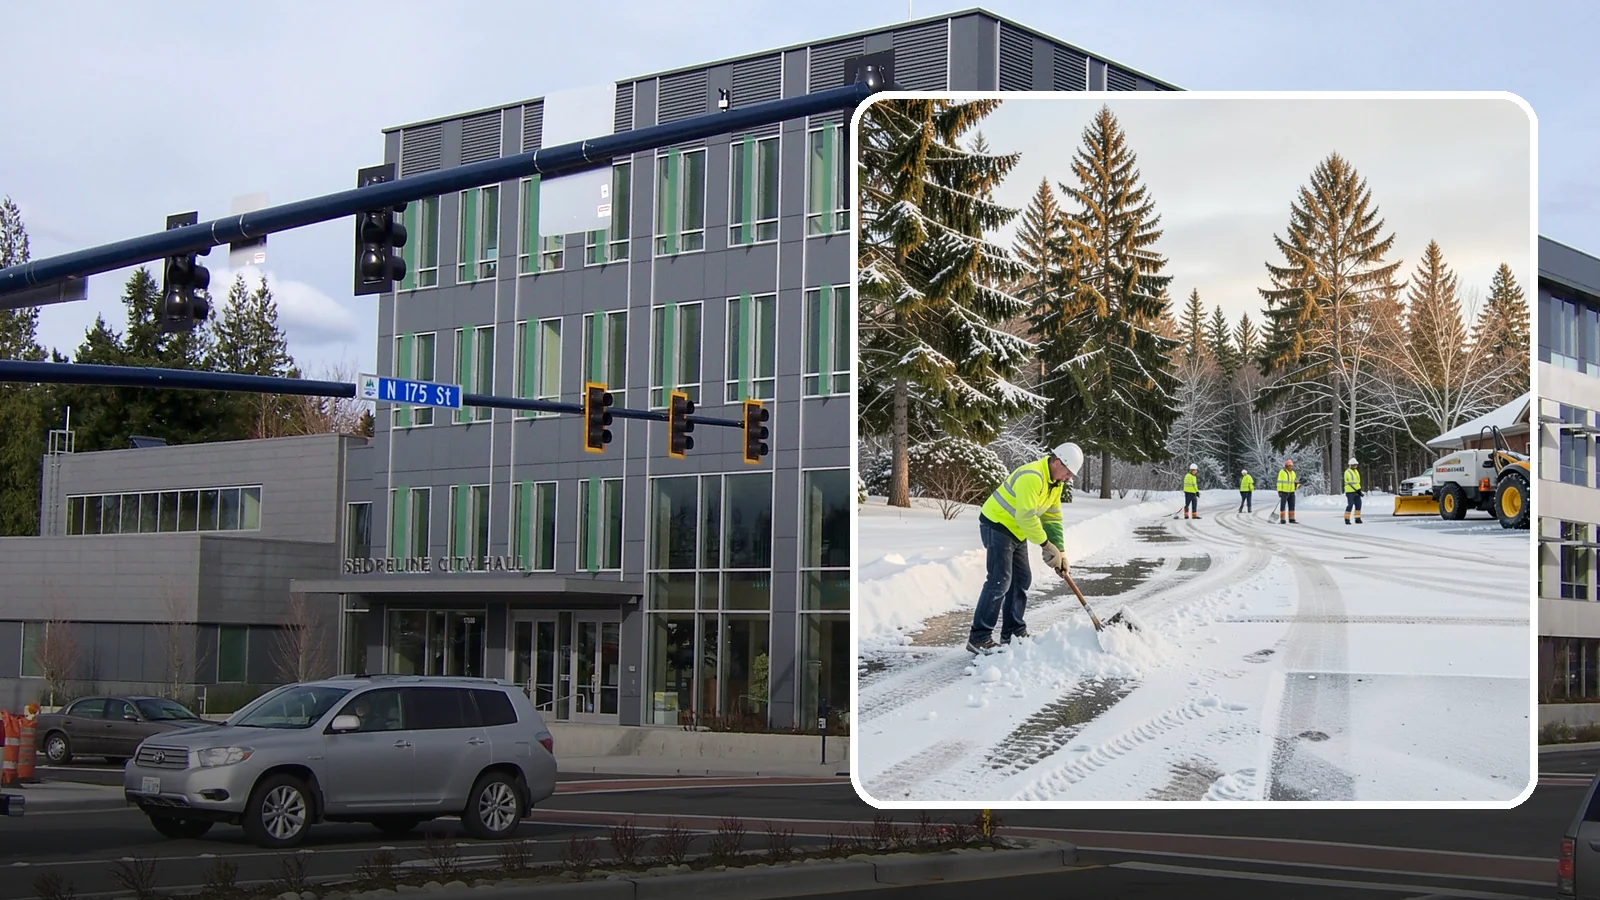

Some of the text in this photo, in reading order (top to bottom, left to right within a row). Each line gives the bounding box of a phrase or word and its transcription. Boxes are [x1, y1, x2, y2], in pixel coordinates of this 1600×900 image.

[387, 380, 451, 406] N 175 St
[344, 555, 525, 574] SHORELINE CITY HALL
